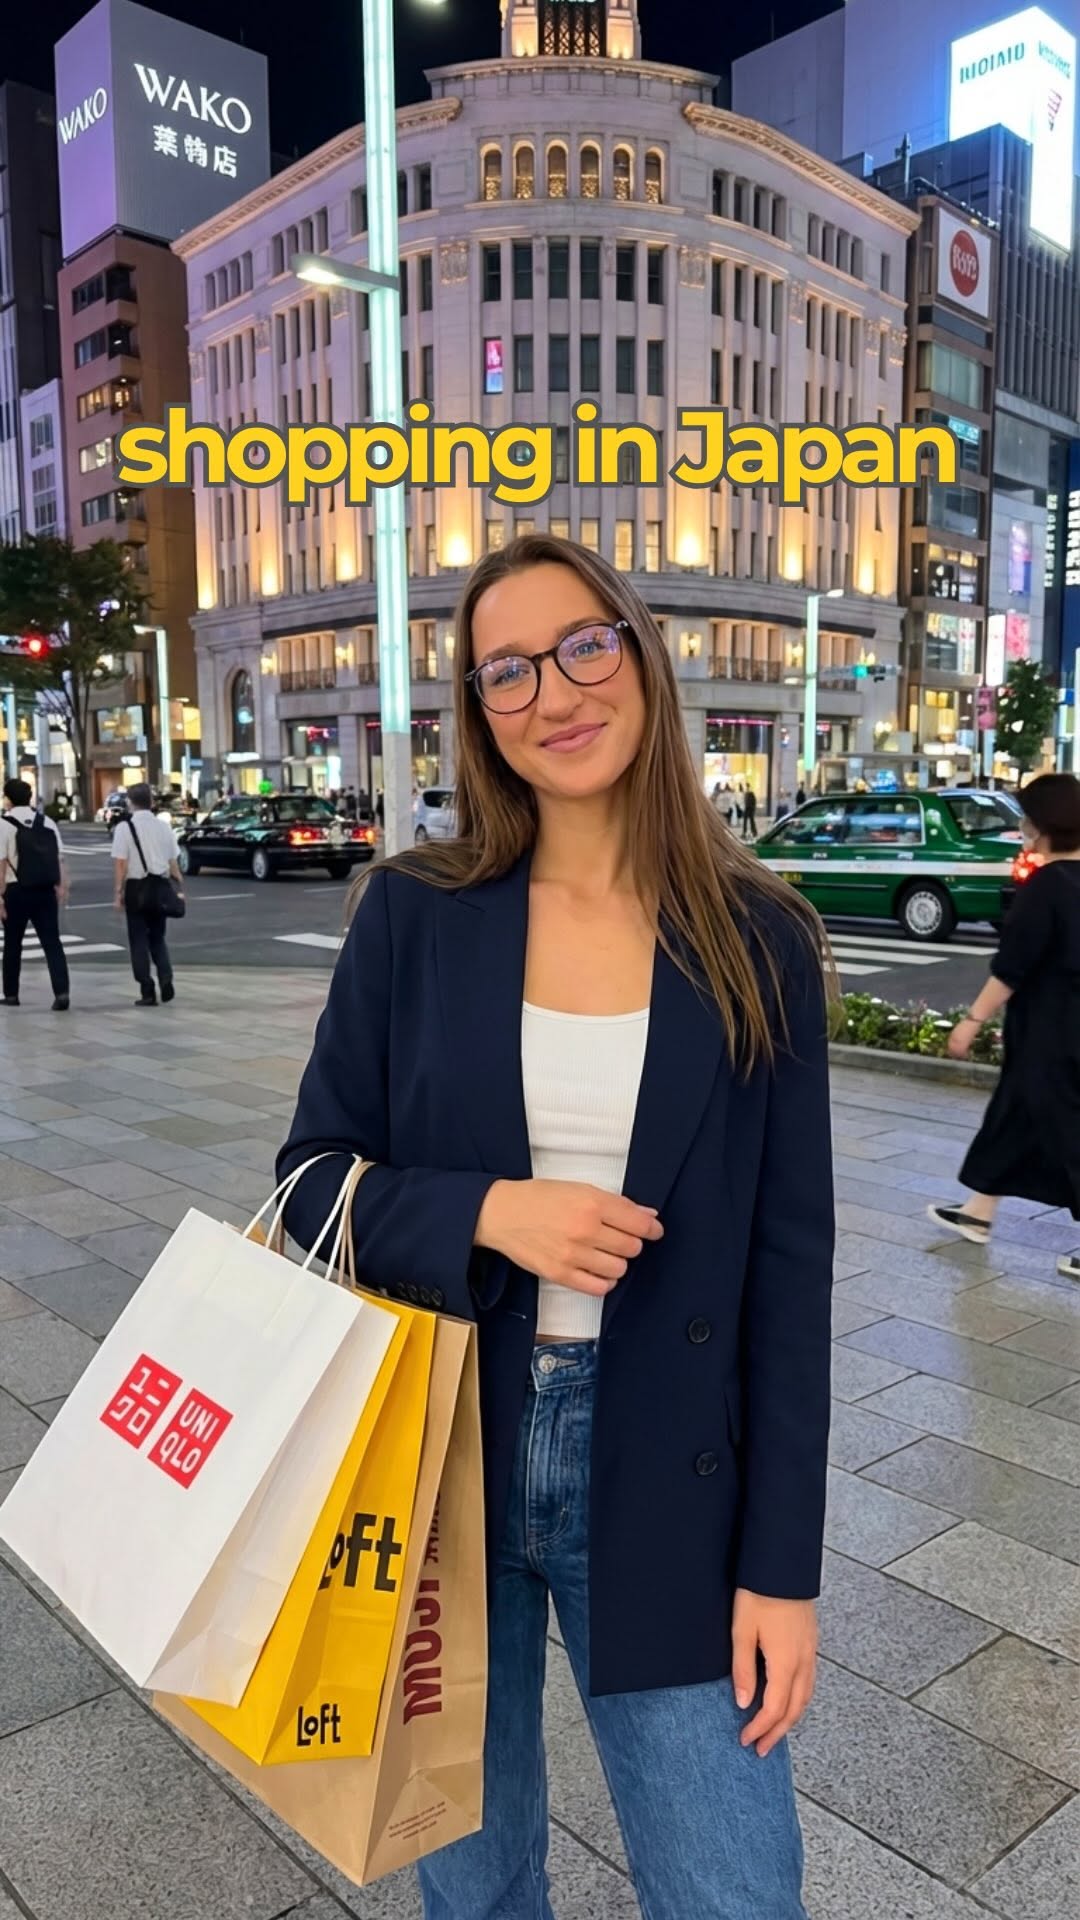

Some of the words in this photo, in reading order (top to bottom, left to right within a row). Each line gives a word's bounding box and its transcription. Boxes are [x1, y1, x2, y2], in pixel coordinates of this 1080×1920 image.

[58, 87, 107, 144] WAKO
[134, 63, 252, 135] WAKO
[128, 1366, 171, 1407] ユニ
[108, 1394, 152, 1437] クロ
[179, 1400, 220, 1443] UNI
[160, 1431, 202, 1475] QLO
[403, 1579, 442, 1726] MUJI
[296, 1703, 341, 1747] Loft
